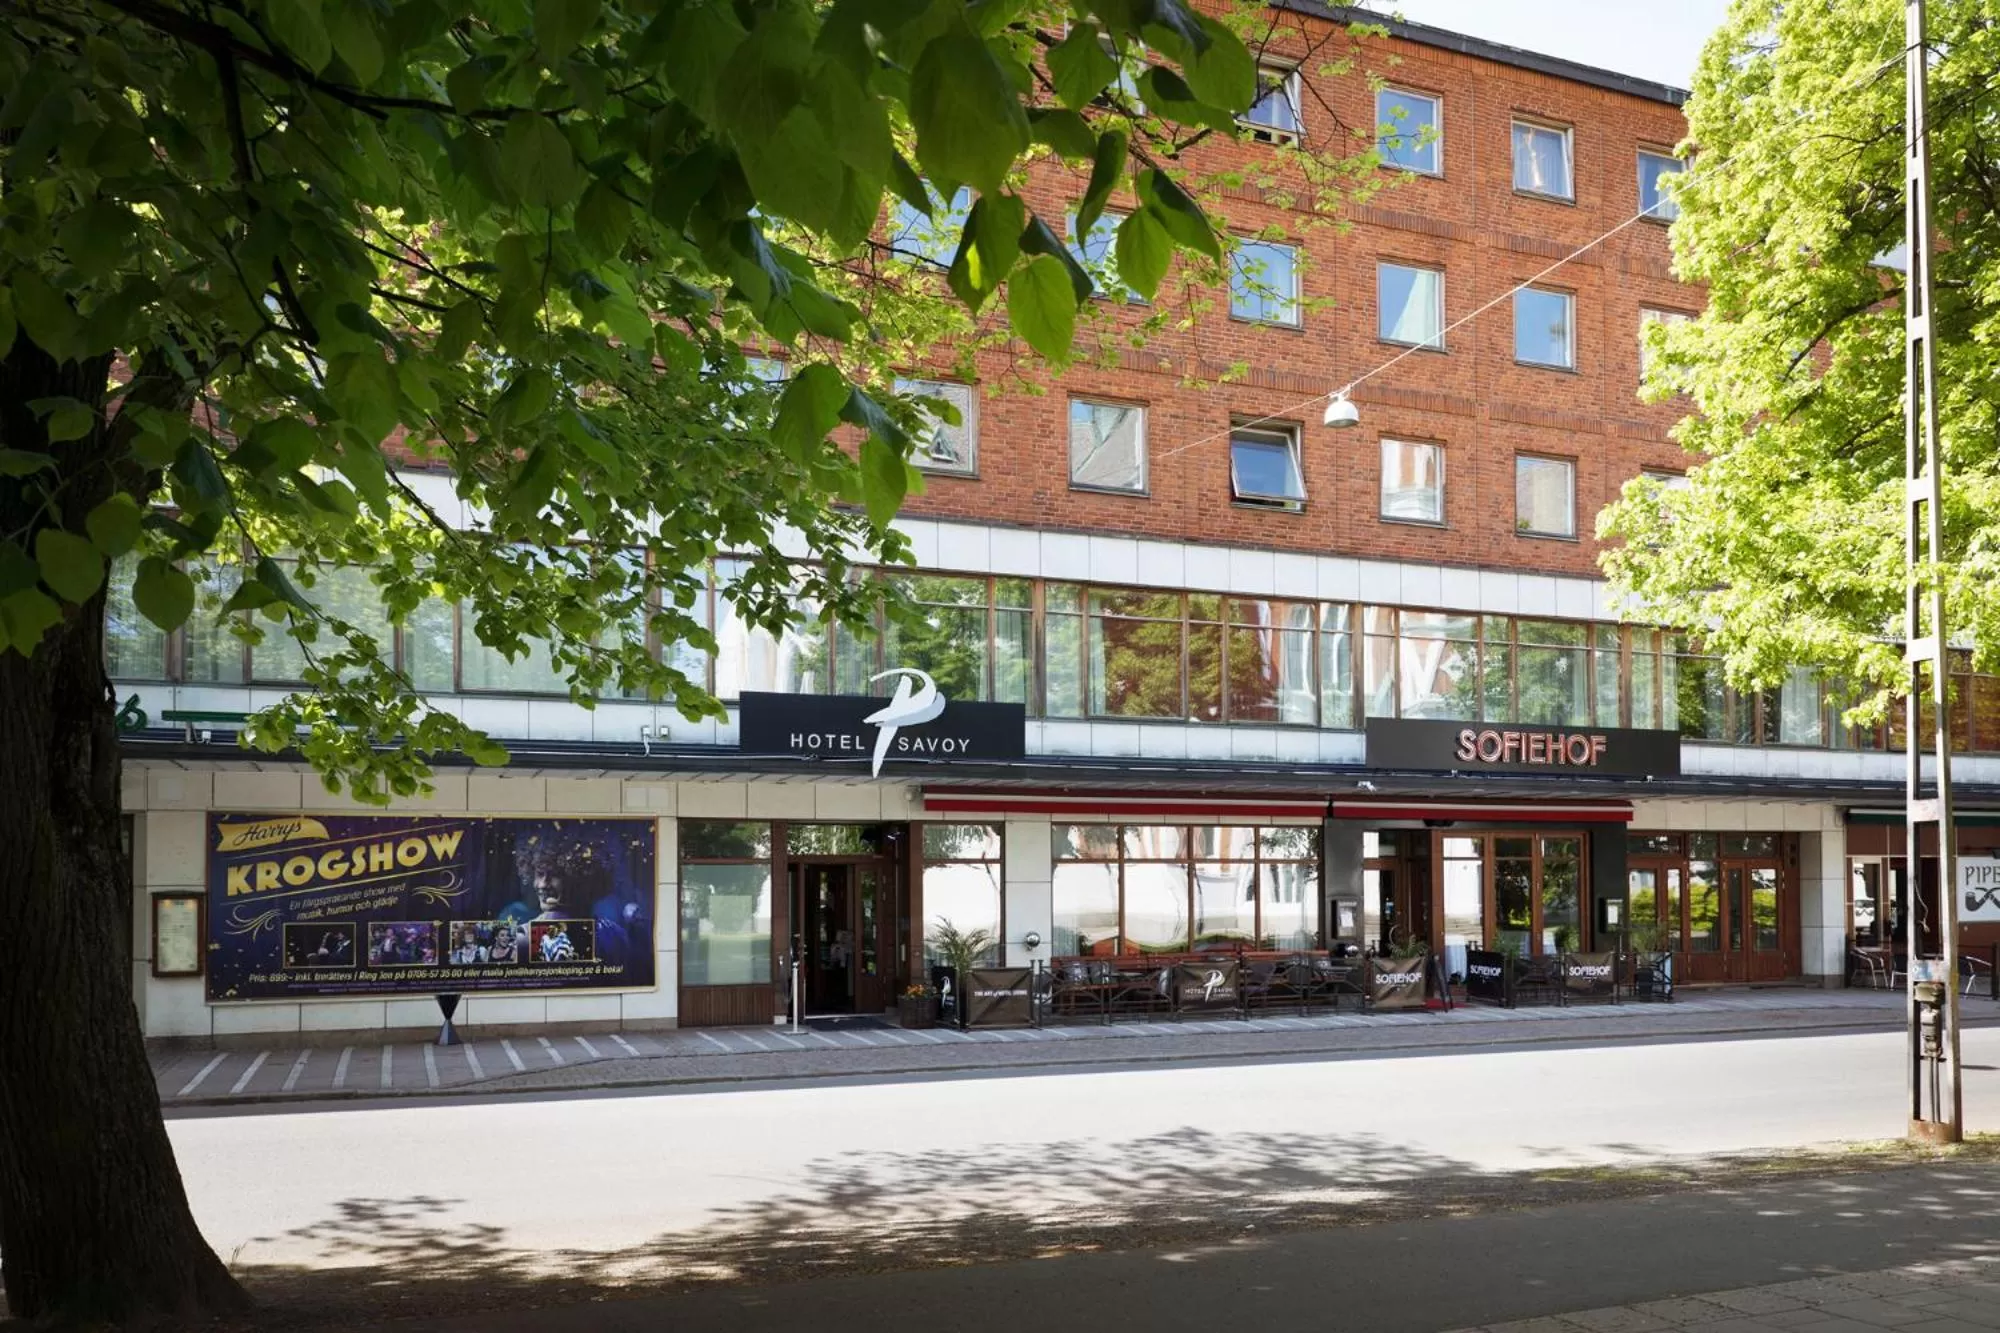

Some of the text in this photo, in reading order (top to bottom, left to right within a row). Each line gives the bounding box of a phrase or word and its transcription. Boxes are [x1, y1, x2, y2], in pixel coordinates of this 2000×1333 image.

[790, 733, 970, 752] HOTEL SAVOY
[1457, 729, 1607, 766] SOFIEHOF
[233, 822, 301, 846] Harrys
[227, 830, 464, 896] KROGSHOW
[364, 886, 386, 898] show
[387, 882, 406, 893] med
[326, 903, 353, 916] humor
[355, 900, 371, 911] och
[359, 971, 377, 981] Ring
[395, 970, 406, 980] på
[1375, 972, 1422, 984] SOFIEHOF
[1569, 965, 1611, 977] SOFIEHOF
